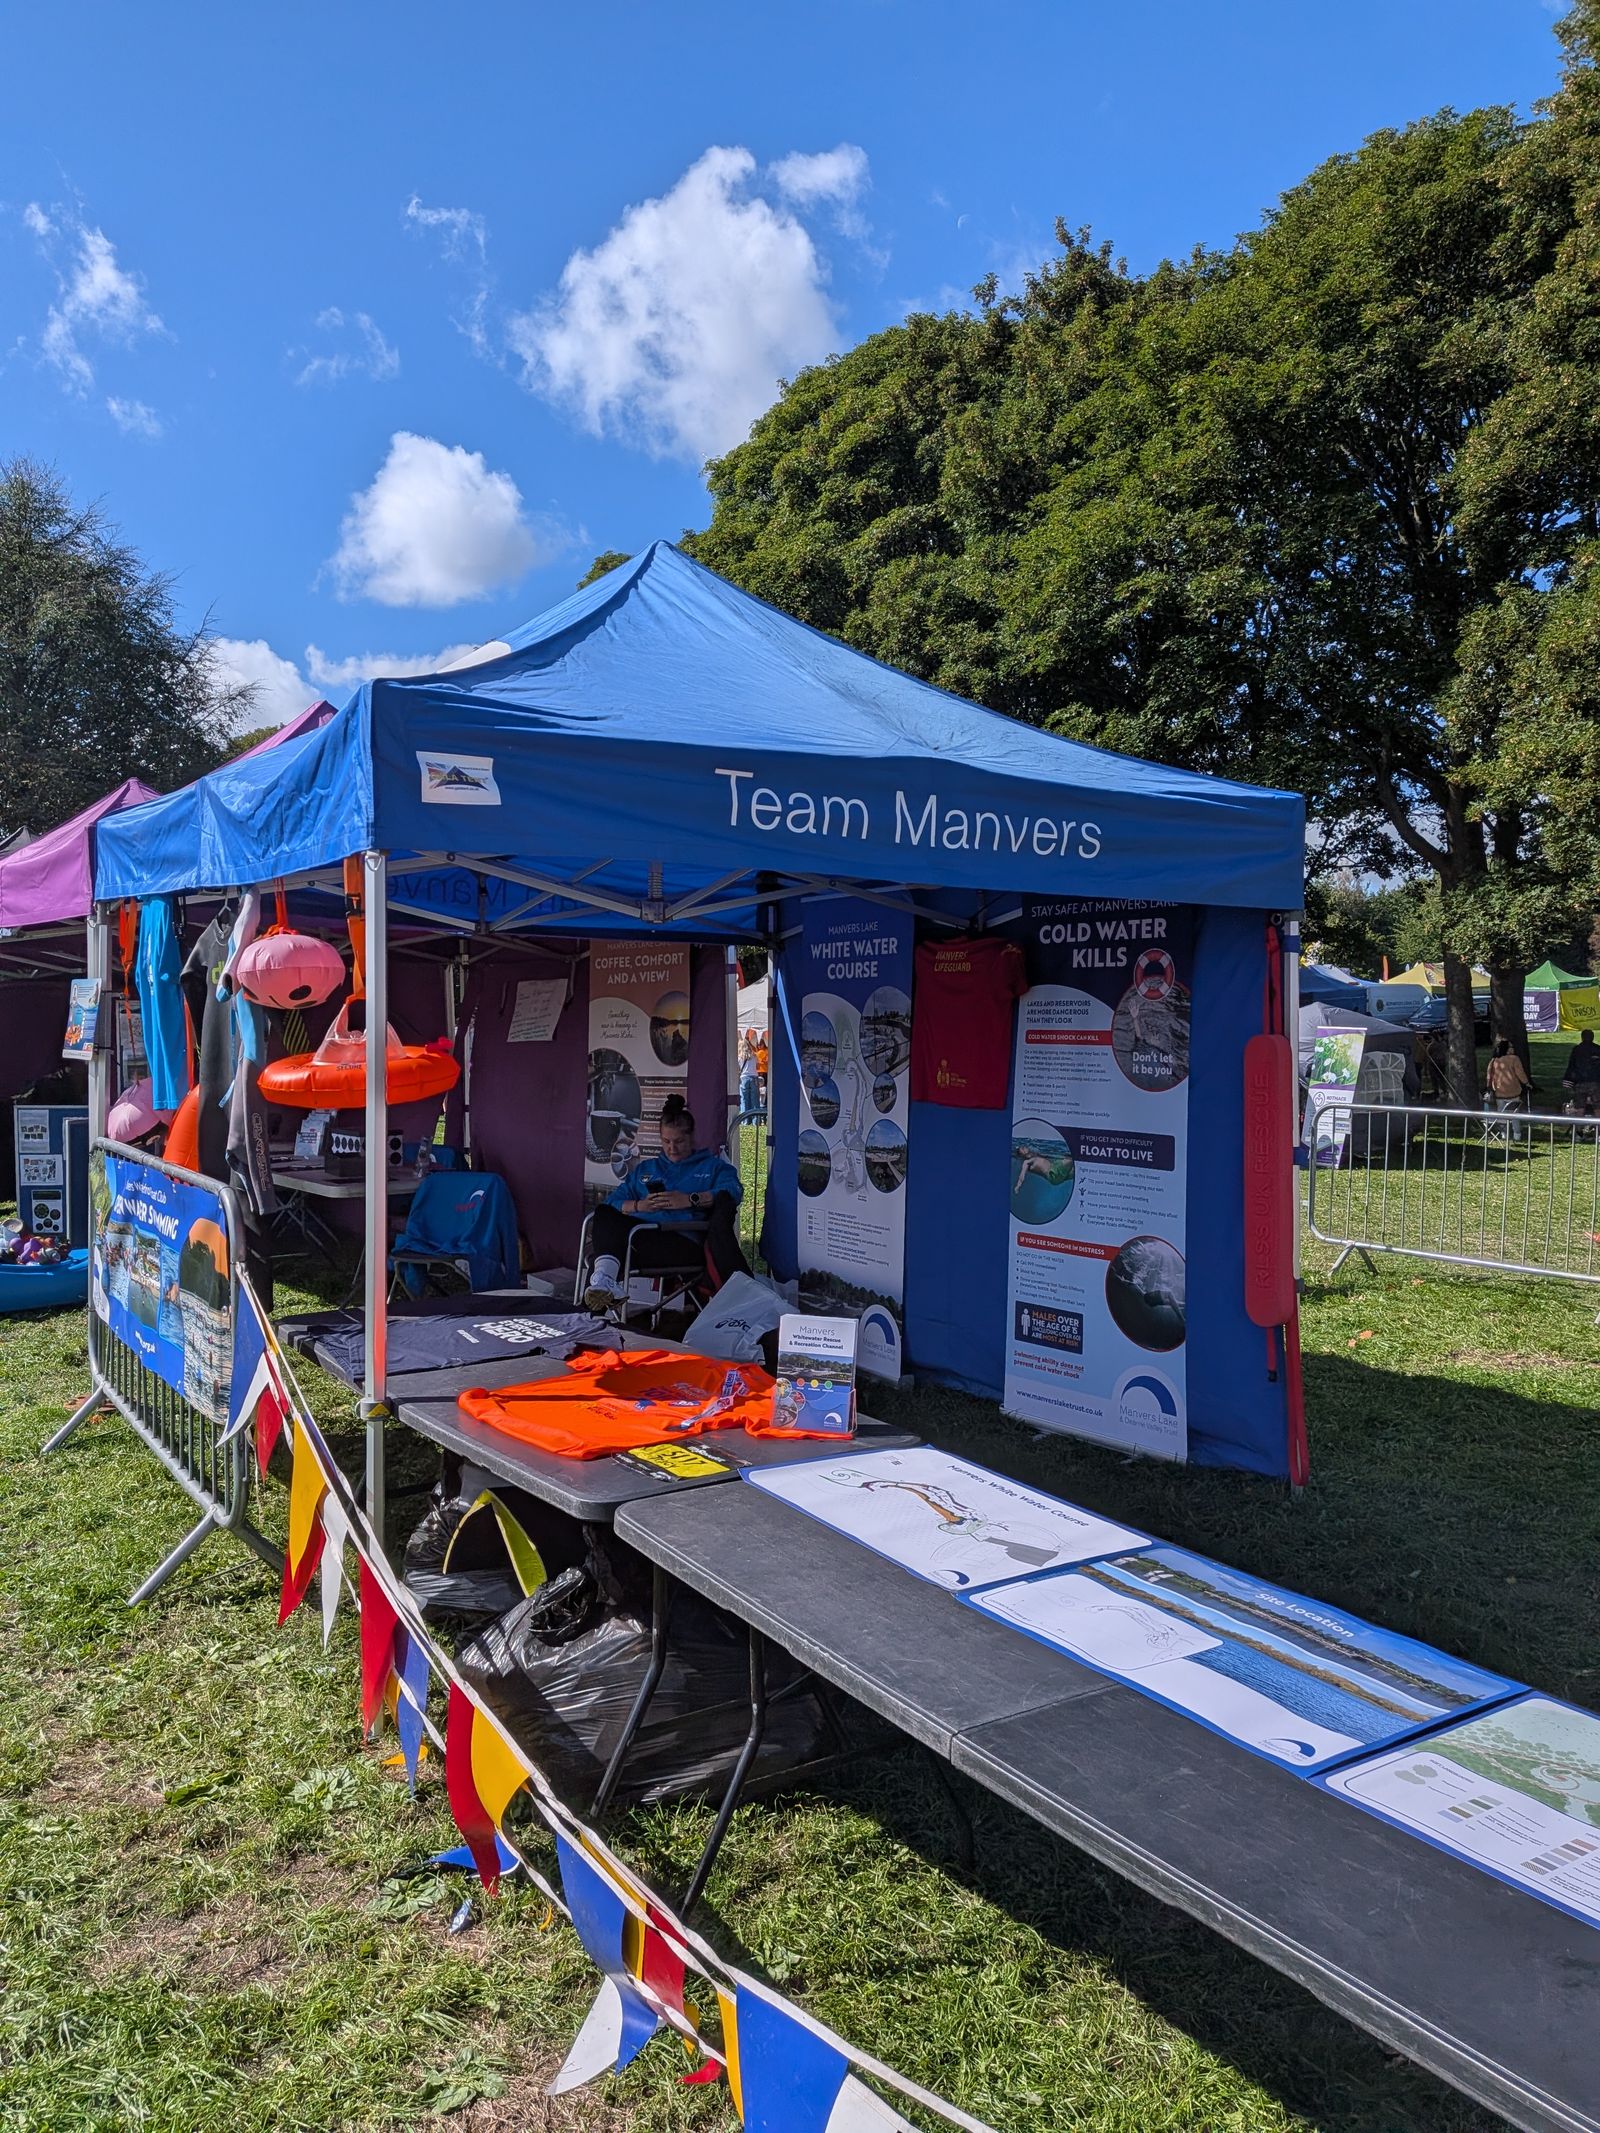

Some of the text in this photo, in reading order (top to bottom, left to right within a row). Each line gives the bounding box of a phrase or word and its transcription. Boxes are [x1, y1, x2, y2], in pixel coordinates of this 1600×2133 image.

[715, 768, 1102, 859] Team Manvers
[1032, 906, 1053, 917] STAY
[1055, 902, 1078, 915] SAFE
[1081, 902, 1092, 913] AT
[1096, 900, 1148, 912] MANVERS
[828, 922, 878, 935] MANVERS LAKE
[1039, 918, 1167, 944] COLD WATER
[811, 938, 898, 959] WHITE WATER
[936, 952, 968, 960] MANVERS
[595, 953, 684, 969] COFFEE, COMFORT
[1072, 948, 1127, 968] KILLS
[827, 961, 878, 979] COURSE
[934, 962, 971, 972] LIFEGUARD
[608, 970, 669, 984] AND A VIEW!
[1572, 1006, 1596, 1017] UNISON
[1132, 1052, 1173, 1063] Don't let
[1132, 1064, 1172, 1077] it be you
[1125, 1139, 1153, 1147] DIFFICULTY
[1080, 1145, 1153, 1161] FLOAT TO LIVE
[1253, 1072, 1272, 1289] RLSS UK RESCUE
[1047, 1241, 1071, 1249] SOMEONE
[1079, 1246, 1105, 1255] DISTRESS
[1032, 1311, 1079, 1327] MALES OVER
[1032, 1318, 1078, 1334] THE AGE OF 15
[472, 1321, 536, 1344] HERO
[800, 1326, 835, 1336] Manvers
[1058, 1330, 1072, 1339] OVER
[1042, 1334, 1057, 1342] MOST
[1066, 1338, 1080, 1346] RISK
[1013, 1359, 1080, 1379] prevent cold water shock
[1014, 1350, 1041, 1363] Swimming
[1042, 1357, 1059, 1367] ability
[1074, 1364, 1084, 1372] not
[1016, 1389, 1103, 1417] www.manverslaketrust.co.uk
[1120, 1404, 1178, 1426] Manvers Lake
[948, 1464, 1089, 1527] Manvers White Water Course
[1255, 1593, 1355, 1637] Site Location
